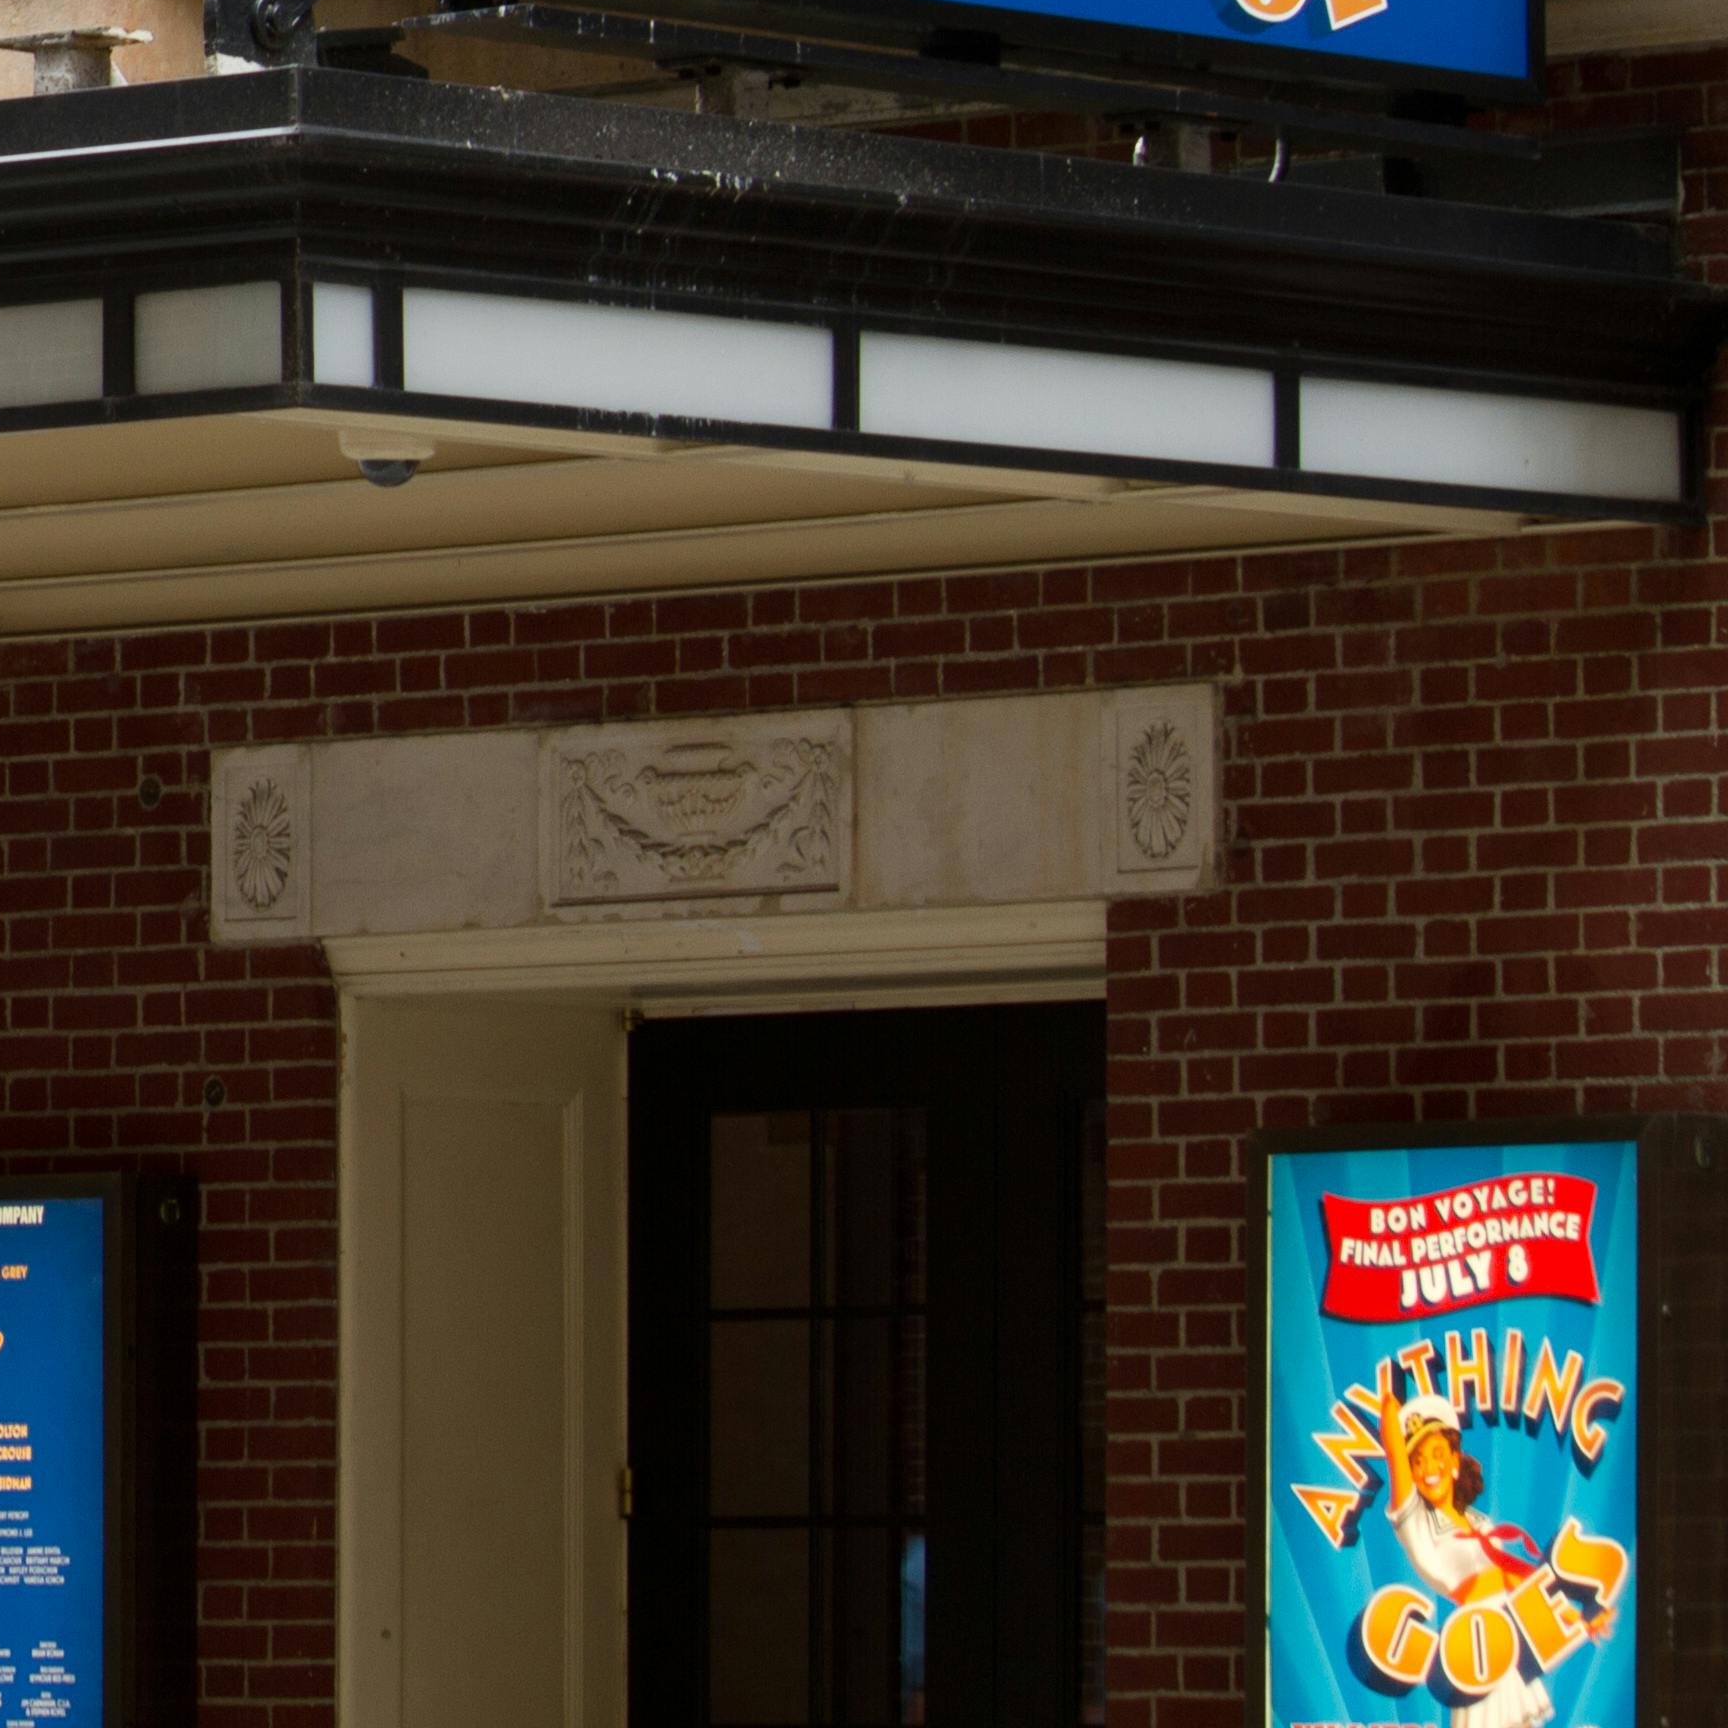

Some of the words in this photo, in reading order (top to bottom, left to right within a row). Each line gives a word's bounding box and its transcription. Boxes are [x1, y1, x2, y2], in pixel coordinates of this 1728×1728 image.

[1368, 1201, 1427, 1236] BON
[1435, 1178, 1558, 1225] VOYAGE!
[1339, 1237, 1407, 1268] FINAL
[1410, 1212, 1582, 1262] PERFORMANCE
[1, 1264, 29, 1281] GREY
[1397, 1255, 1492, 1310] JULY
[1506, 1242, 1531, 1286] 8
[1289, 1328, 1625, 1551] ANYTHING
[1361, 1516, 1629, 1695] GOES
